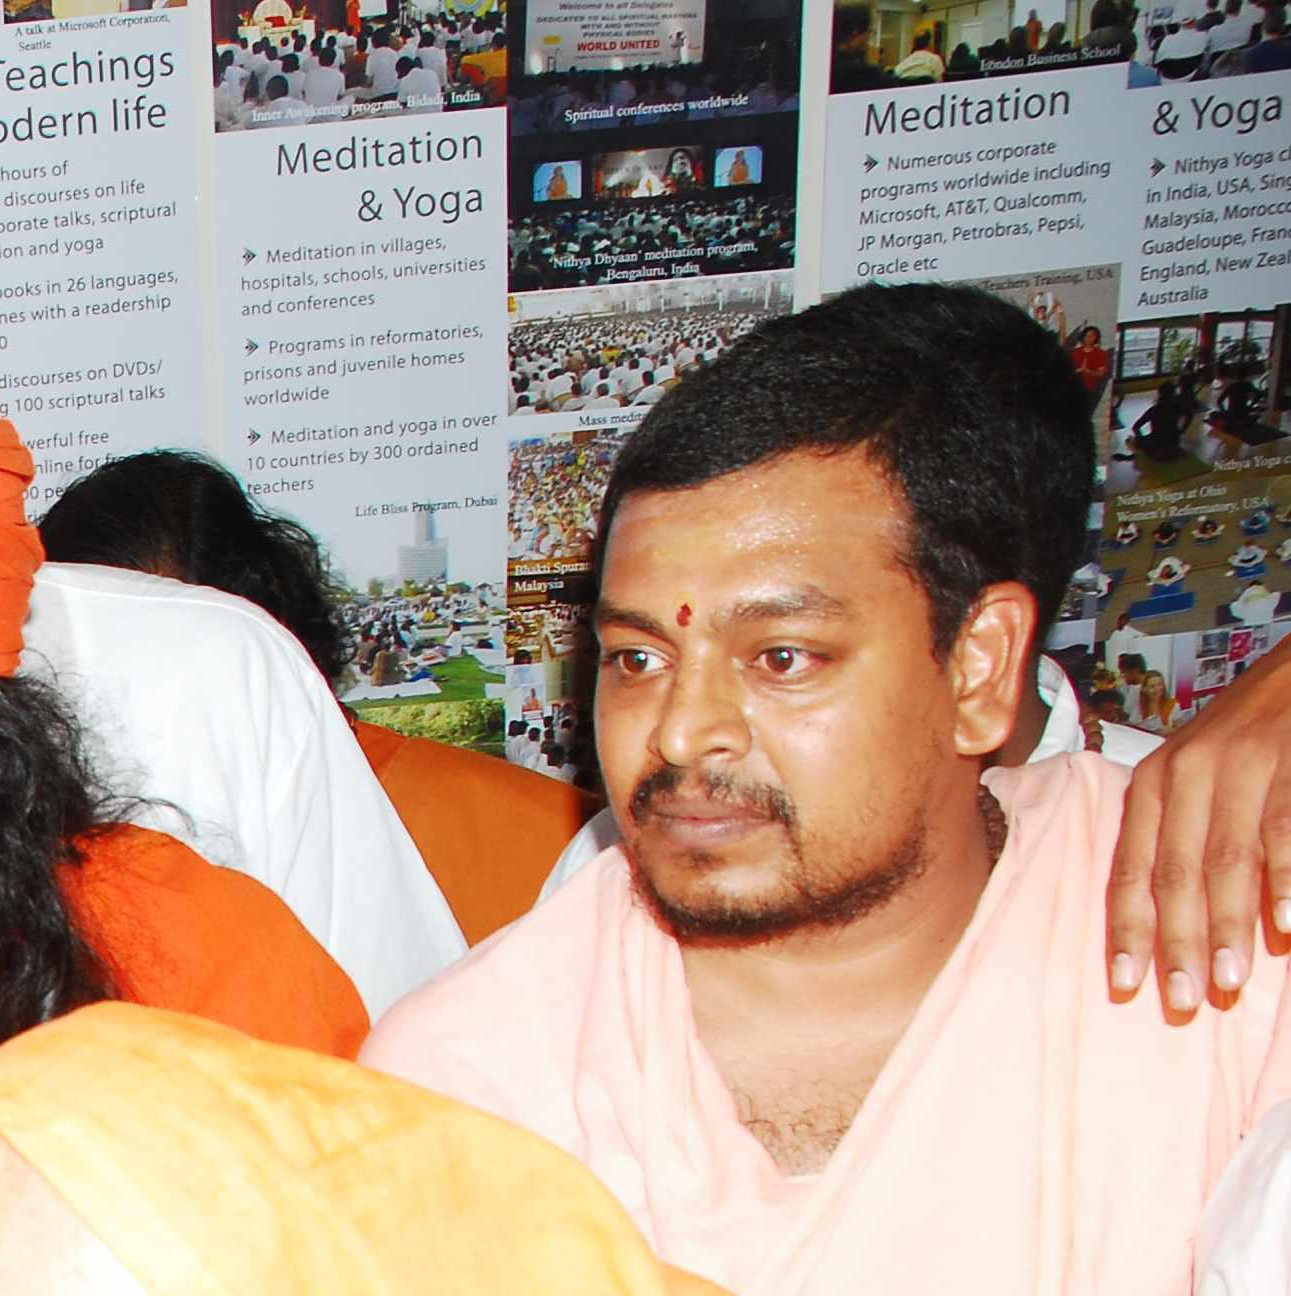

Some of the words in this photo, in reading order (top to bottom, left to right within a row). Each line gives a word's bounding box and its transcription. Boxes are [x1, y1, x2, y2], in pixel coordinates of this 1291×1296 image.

[577, 41, 617, 51] WORLD
[620, 40, 659, 50] UNITED
[113, 94, 166, 132] life
[565, 105, 613, 124] Spiritual
[617, 102, 685, 116] conferences
[687, 94, 749, 109] worldwide
[865, 88, 1069, 136] Meditation
[1153, 101, 1179, 135] &
[1191, 96, 1282, 134] Yoga
[278, 132, 481, 176] Meditation
[888, 152, 971, 170] Numerous
[977, 142, 1057, 162] corporate
[1175, 156, 1229, 174] Nithya
[1234, 152, 1273, 170] Yoga
[0, 166, 47, 182] hours
[51, 160, 68, 176] of
[861, 181, 938, 203] programs
[943, 168, 1030, 190] worldwide
[1034, 162, 1111, 181] including
[54, 210, 95, 228] talks,
[100, 202, 175, 224] scriptural
[358, 190, 382, 222] &
[393, 186, 482, 224] Yoga
[860, 203, 941, 224] Microsoft,
[945, 198, 989, 216] AT&T,
[993, 192, 1087, 212] Qualcomm,
[29, 238, 59, 256] and
[63, 238, 105, 256] yoga
[858, 236, 875, 251] JP
[880, 232, 947, 250] Morgan,
[953, 222, 1033, 240] Petrobras,
[1038, 214, 1084, 234] Pepsi,
[267, 245, 355, 263] Meditation
[361, 242, 375, 256] in
[381, 238, 446, 255] villages,
[241, 272, 318, 292] hospitals,
[323, 266, 387, 284] schools,
[393, 258, 486, 278] universities
[606, 267, 667, 281] Bengaluru,
[671, 262, 700, 275] India
[857, 258, 909, 276] Oracle
[913, 258, 939, 271] etc
[241, 299, 272, 316] and
[277, 294, 375, 312] conferences
[269, 338, 345, 356] Programs
[351, 335, 365, 347] in
[371, 326, 483, 346] reformatories,
[244, 366, 302, 384] prisons
[307, 360, 337, 376] and
[341, 354, 406, 376] juvenile
[411, 352, 465, 366] homes
[244, 386, 329, 405] worldwide
[514, 578, 563, 592] Malaysia
